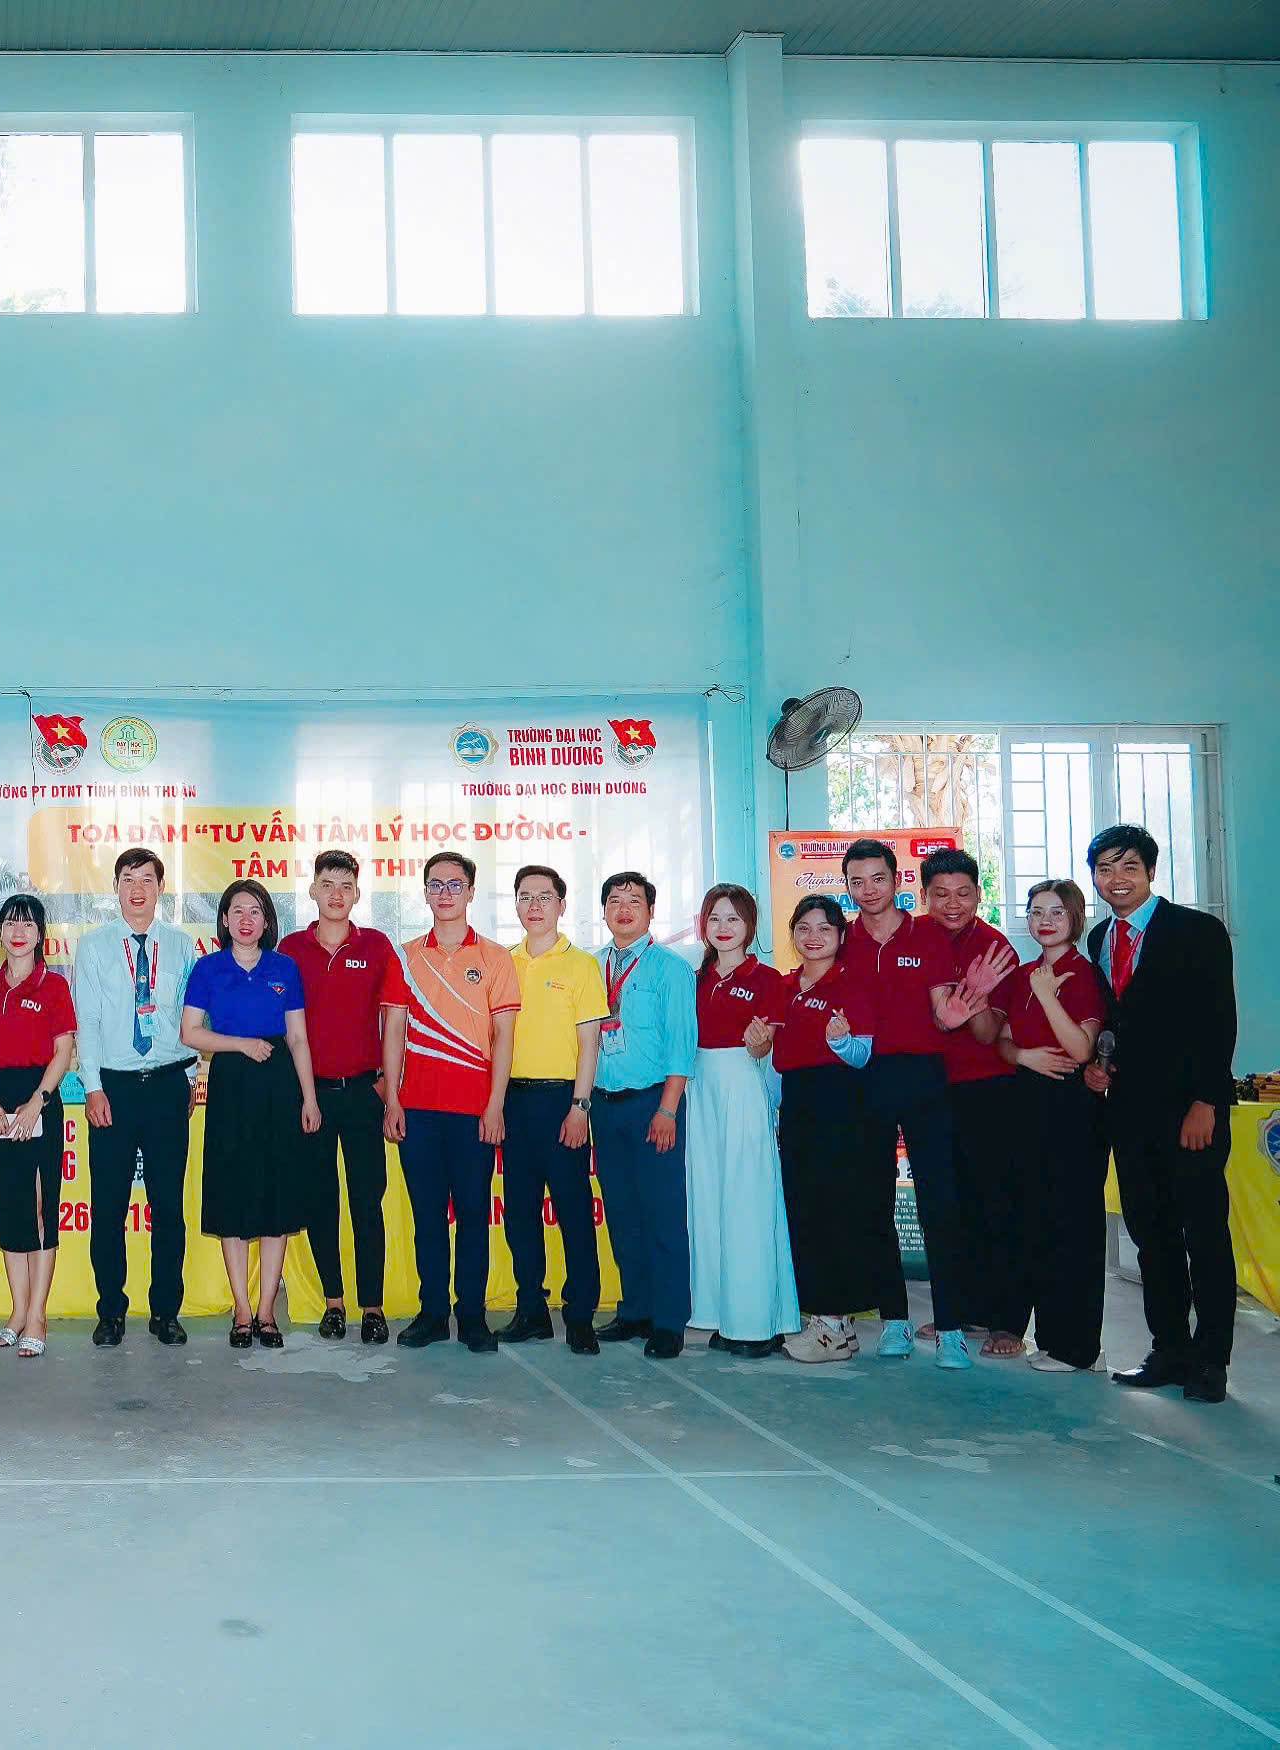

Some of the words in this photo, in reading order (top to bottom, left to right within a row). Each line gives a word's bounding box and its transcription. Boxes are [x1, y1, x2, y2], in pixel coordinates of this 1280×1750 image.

[507, 727, 553, 743] TRƯỜNG
[555, 729, 576, 745] ĐẠI
[579, 728, 602, 745] HỌC
[509, 744, 546, 766] BÌNH
[551, 746, 604, 766] DƯƠNG
[31, 785, 47, 799] PT
[51, 785, 83, 798] DTNT
[461, 781, 511, 796] TRƯỜNG
[515, 783, 537, 799] ĐẠI
[541, 783, 567, 799] HỌC
[571, 780, 601, 795] BÌNH
[605, 781, 647, 795] DƯƠNG
[67, 824, 121, 849] TỌA
[128, 816, 188, 843] ĐÀM
[250, 810, 306, 843] VẤN
[313, 816, 368, 842] TÂM
[375, 815, 404, 842] LÝ
[411, 823, 467, 848] HỌC
[472, 813, 573, 841] ĐƯỜNG
[232, 852, 288, 878] TÂM
[345, 959, 367, 968] BDU
[897, 957, 921, 967] BDU
[729, 987, 754, 1001] BDU
[804, 997, 828, 1010] BDU
